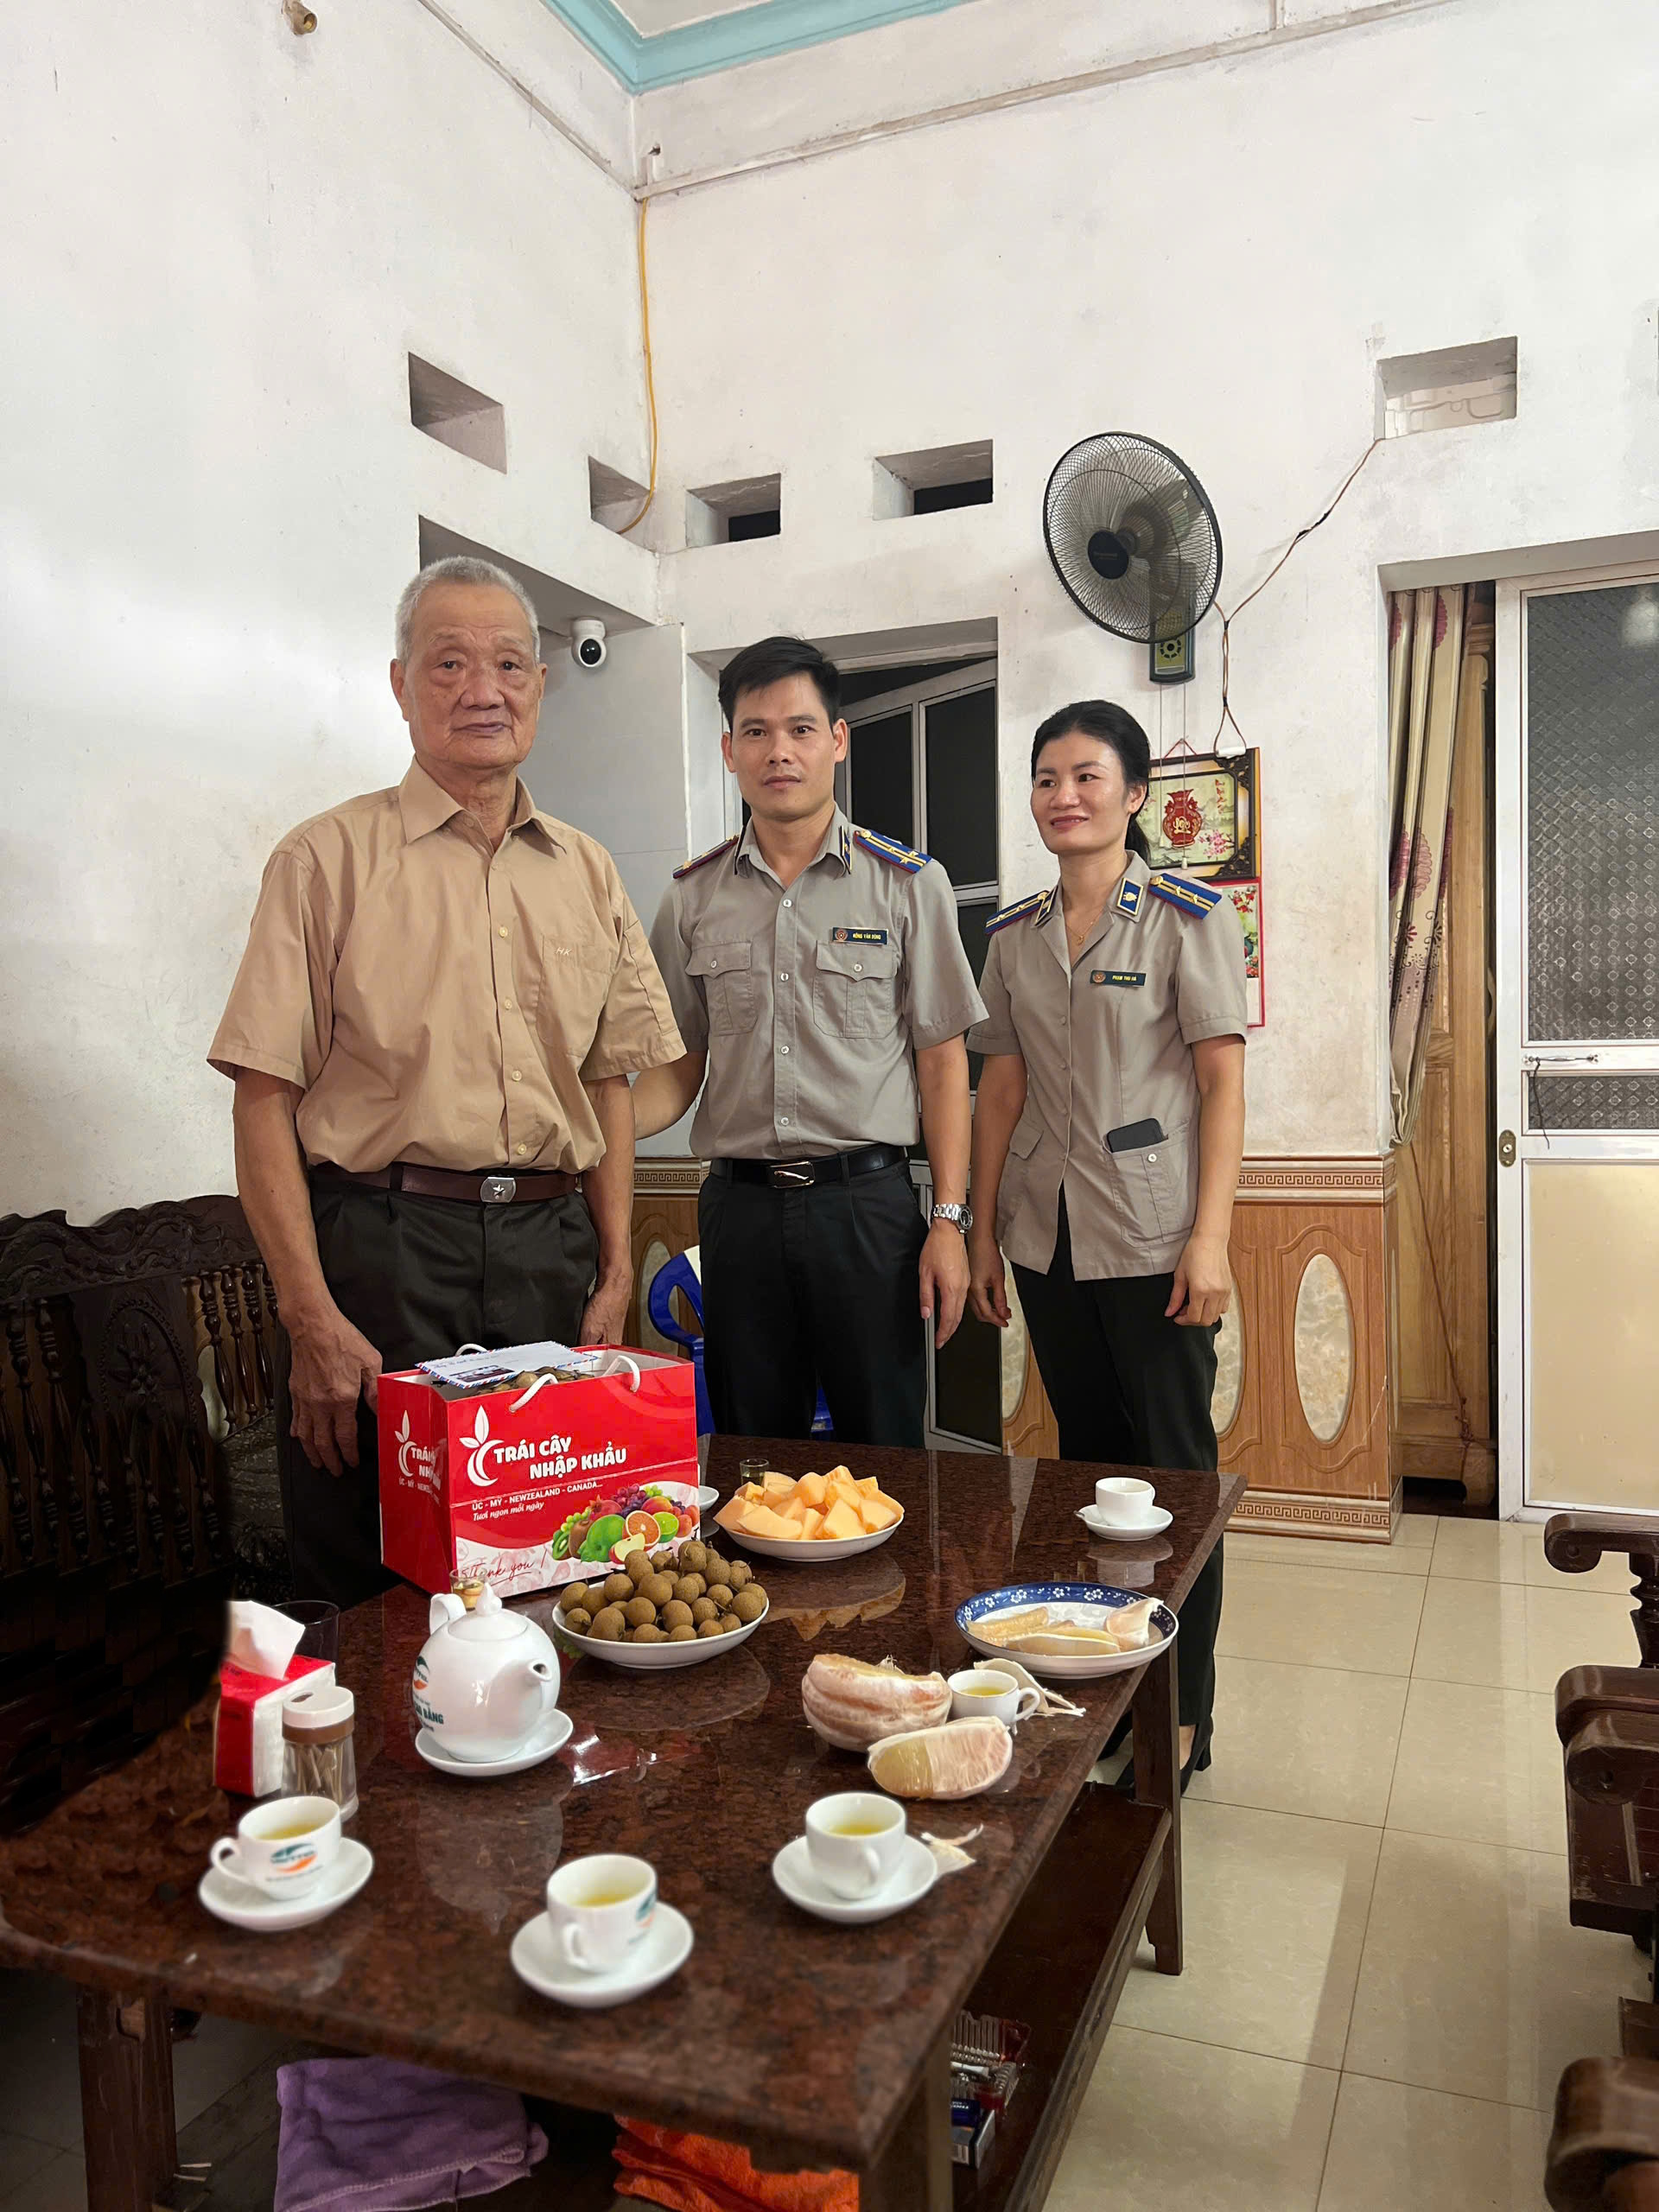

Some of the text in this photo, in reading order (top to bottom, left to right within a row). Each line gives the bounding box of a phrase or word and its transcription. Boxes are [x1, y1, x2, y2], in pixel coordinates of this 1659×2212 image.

[493, 1434, 572, 1464] TRÁI CÂY
[530, 1441, 626, 1479] NHẬP KHẨU
[509, 1488, 561, 1503] NEWZEALAND
[490, 1509, 509, 1518] ngon
